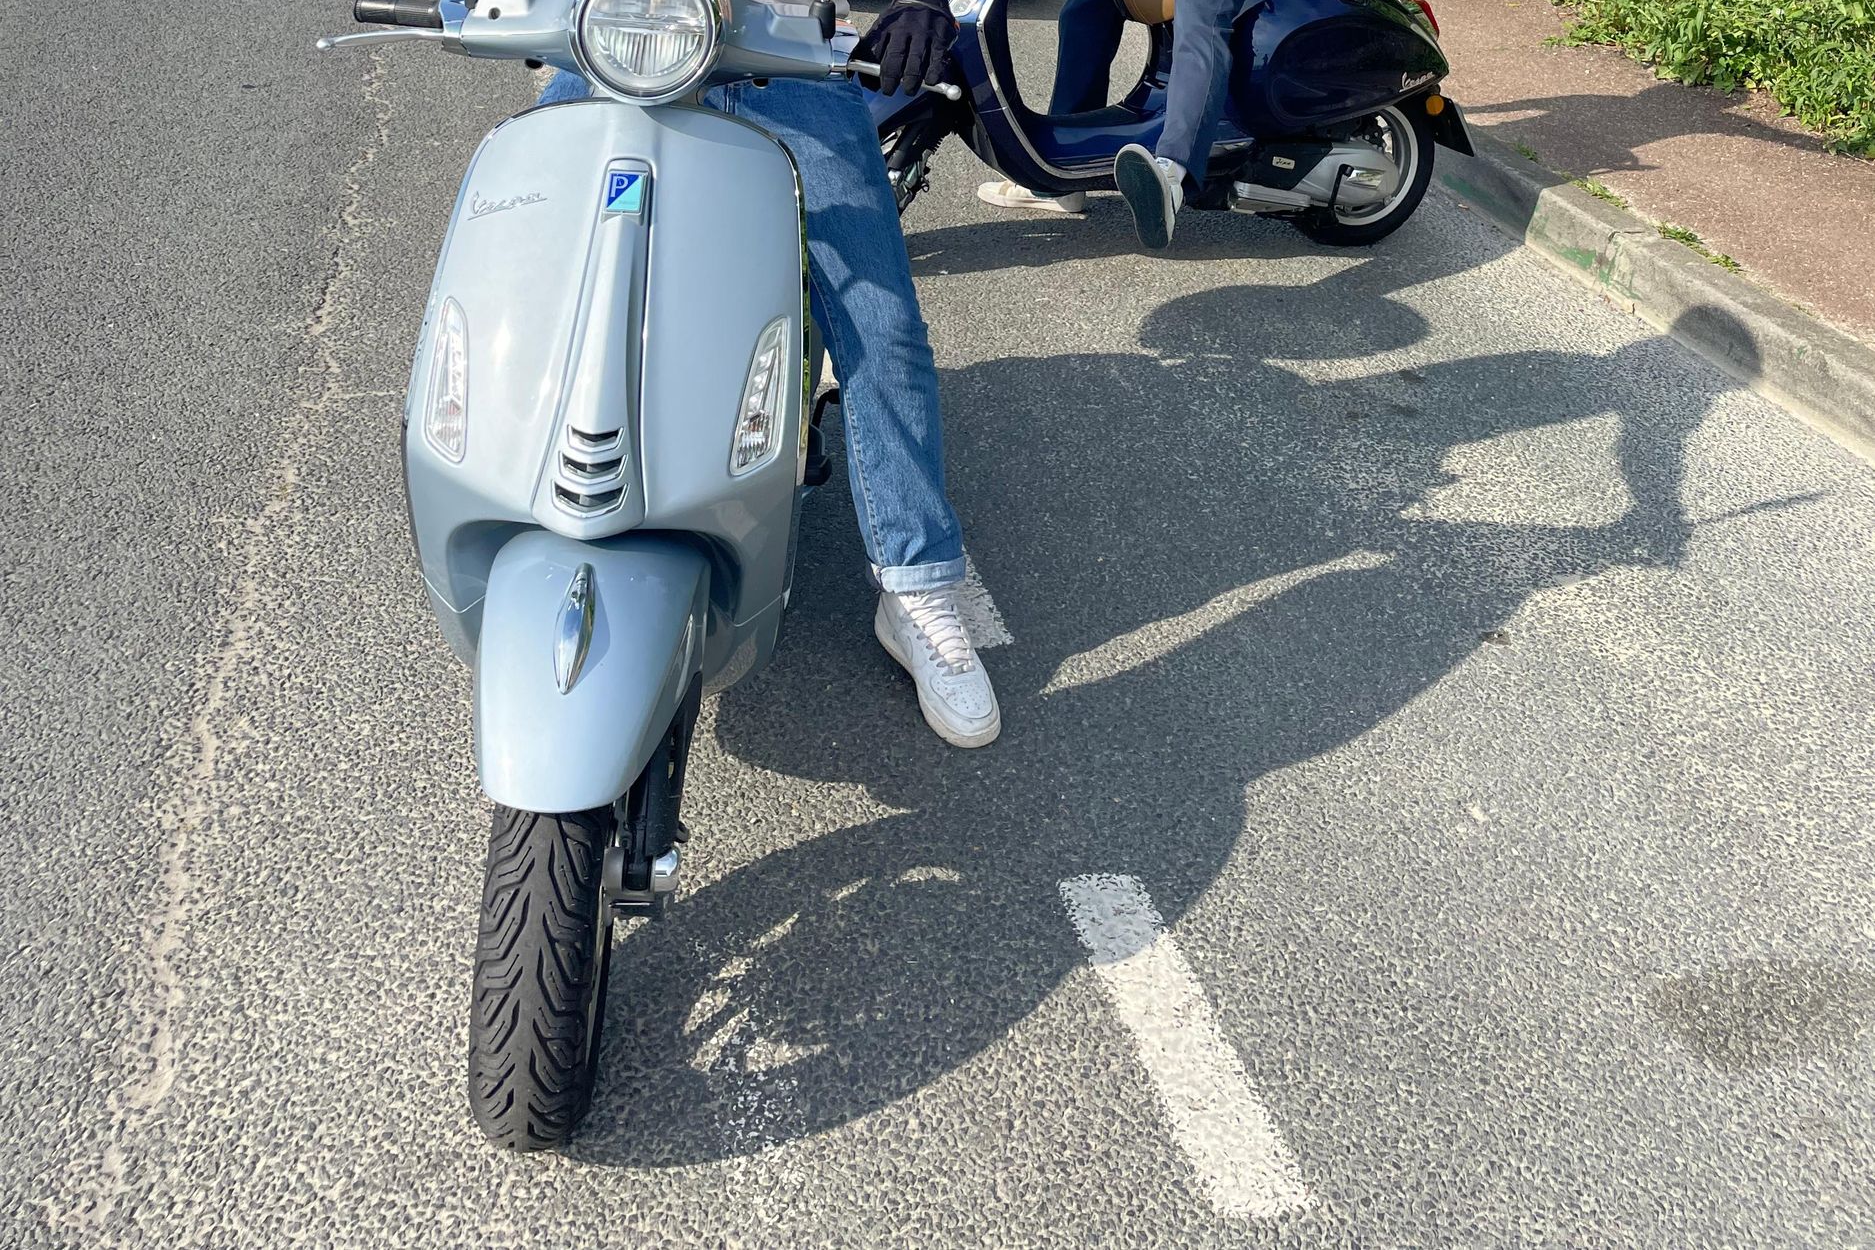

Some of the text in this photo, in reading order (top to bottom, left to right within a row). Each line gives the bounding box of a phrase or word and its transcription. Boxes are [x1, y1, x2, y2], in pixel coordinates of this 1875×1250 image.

[1399, 71, 1435, 93] Vespa
[610, 175, 629, 198] P
[467, 190, 548, 221] Vespa
